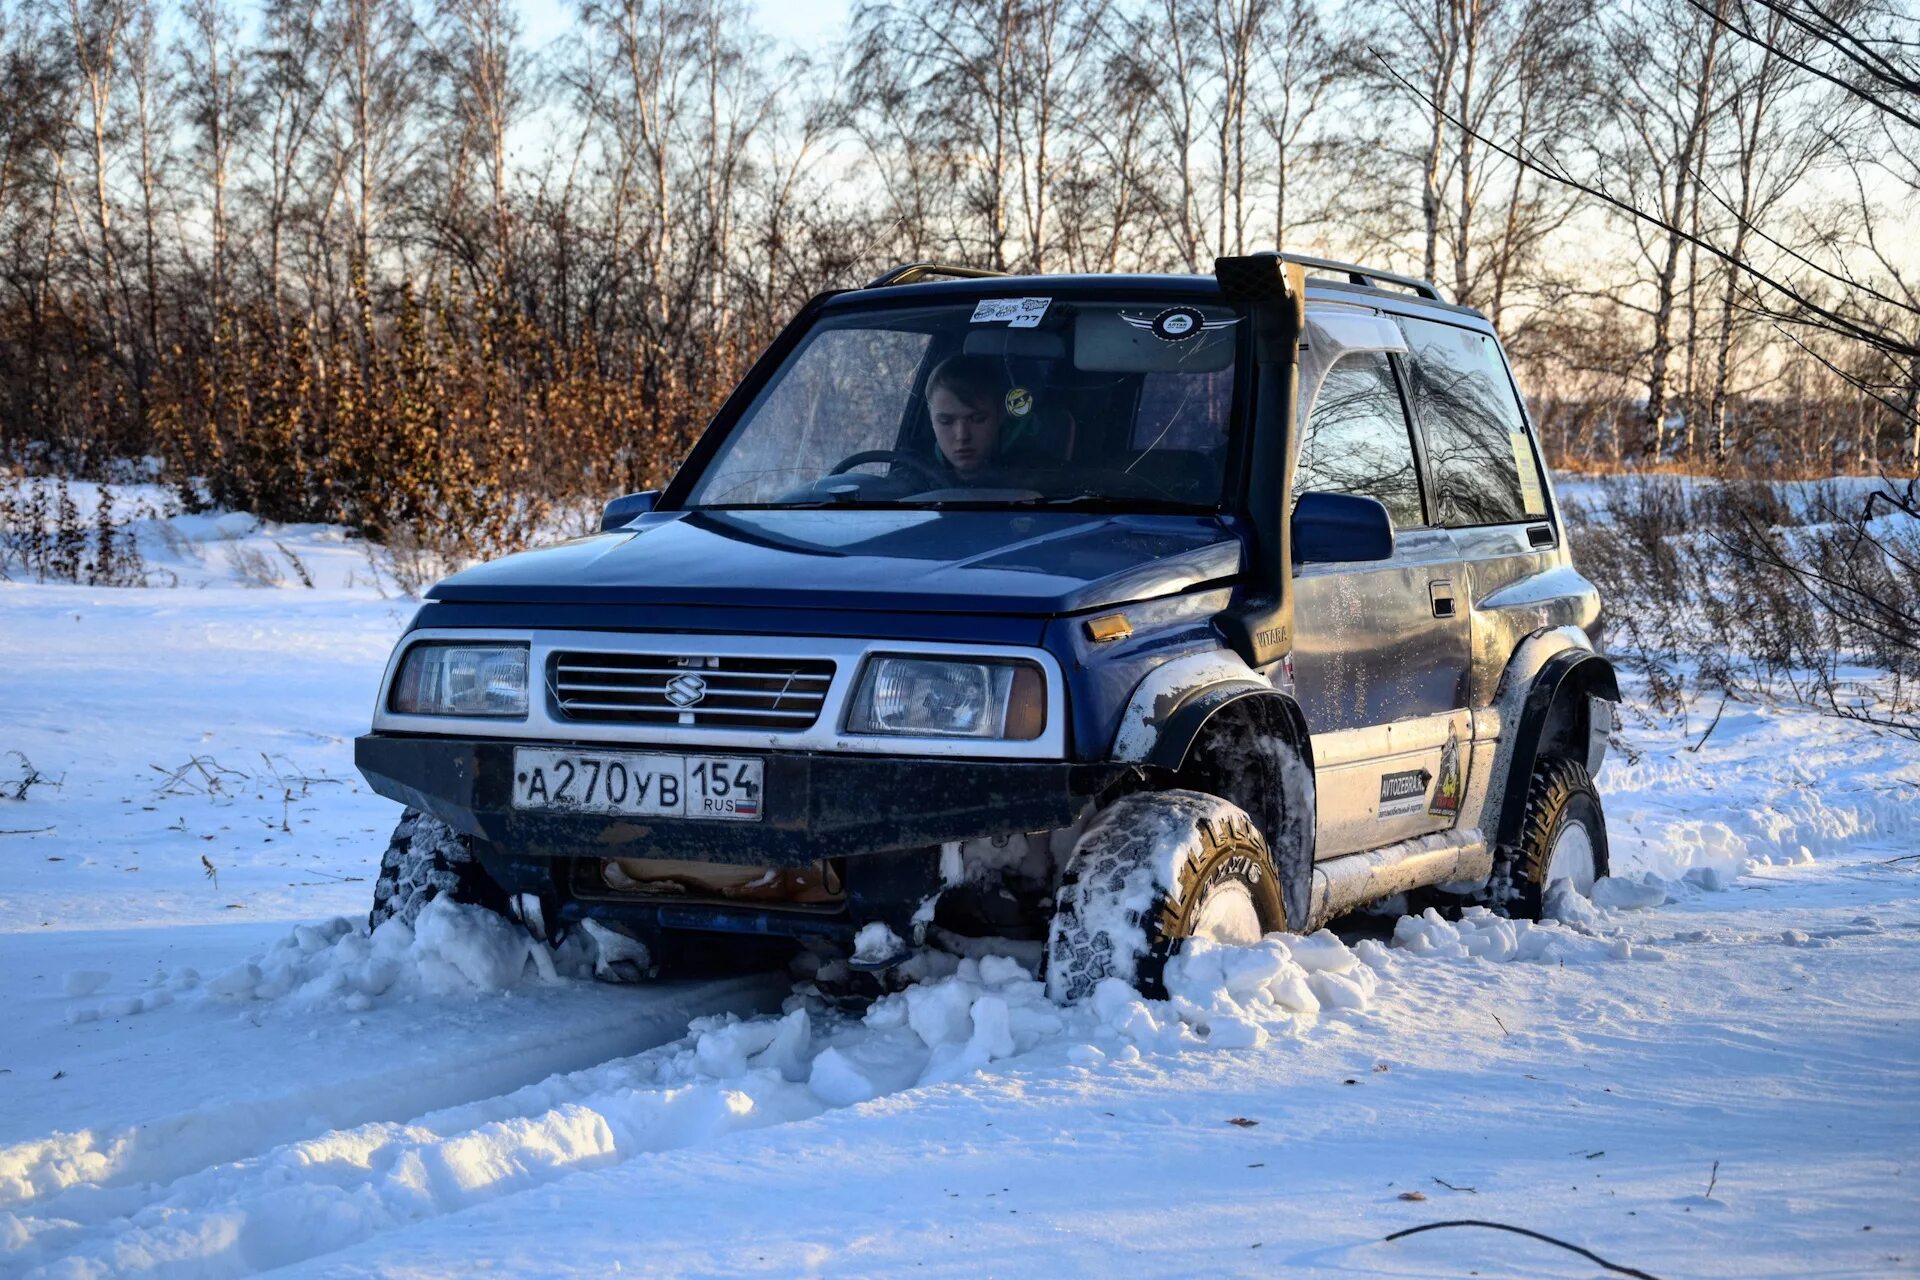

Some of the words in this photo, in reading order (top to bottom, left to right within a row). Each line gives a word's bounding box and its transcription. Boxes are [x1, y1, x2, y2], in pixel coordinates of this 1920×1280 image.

[1256, 625, 1287, 648] VITARA
[692, 763, 753, 798] 154
[704, 798, 734, 812] RUS
